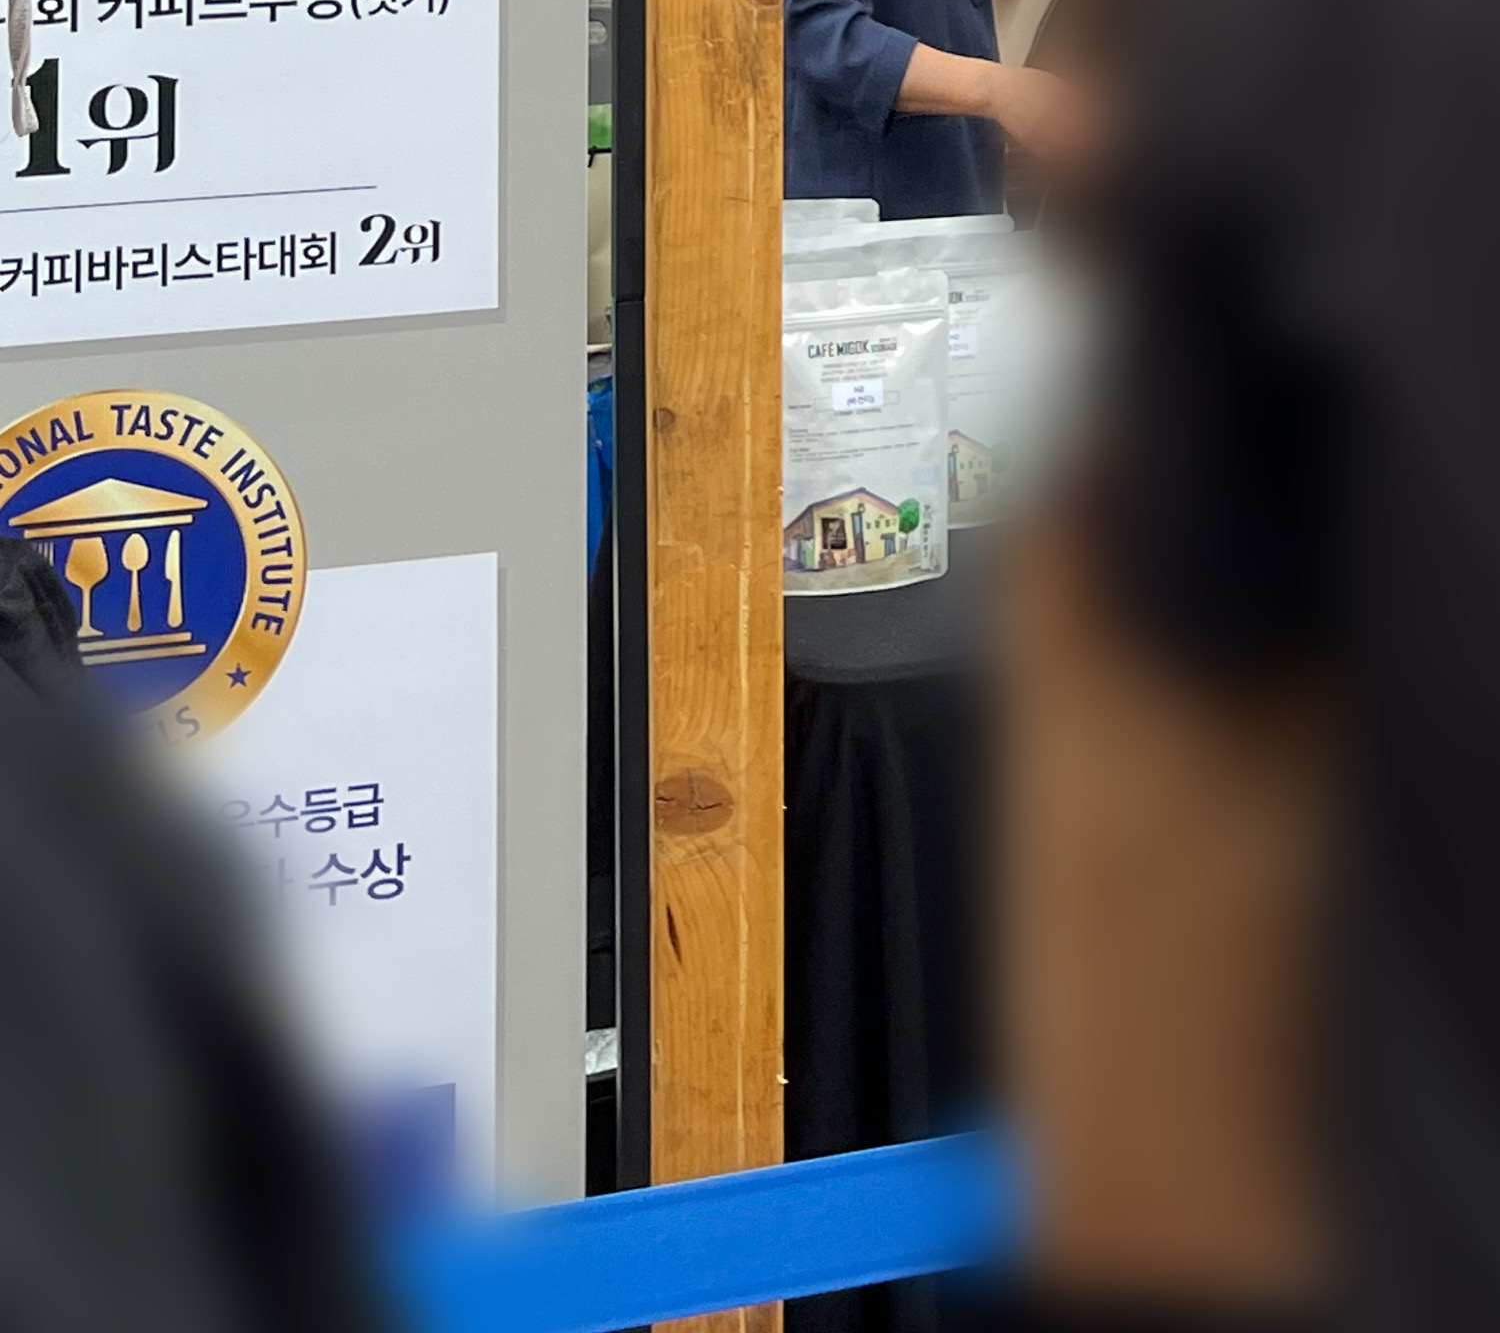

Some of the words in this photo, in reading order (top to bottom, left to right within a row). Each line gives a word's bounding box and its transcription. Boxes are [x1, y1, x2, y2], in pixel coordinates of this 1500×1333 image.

[11, 57, 179, 178] 1위
[358, 213, 442, 267] 2위
[0, 410, 94, 489] ONAL
[110, 404, 224, 459] TASTE
[220, 448, 293, 635] INSTITUTE
